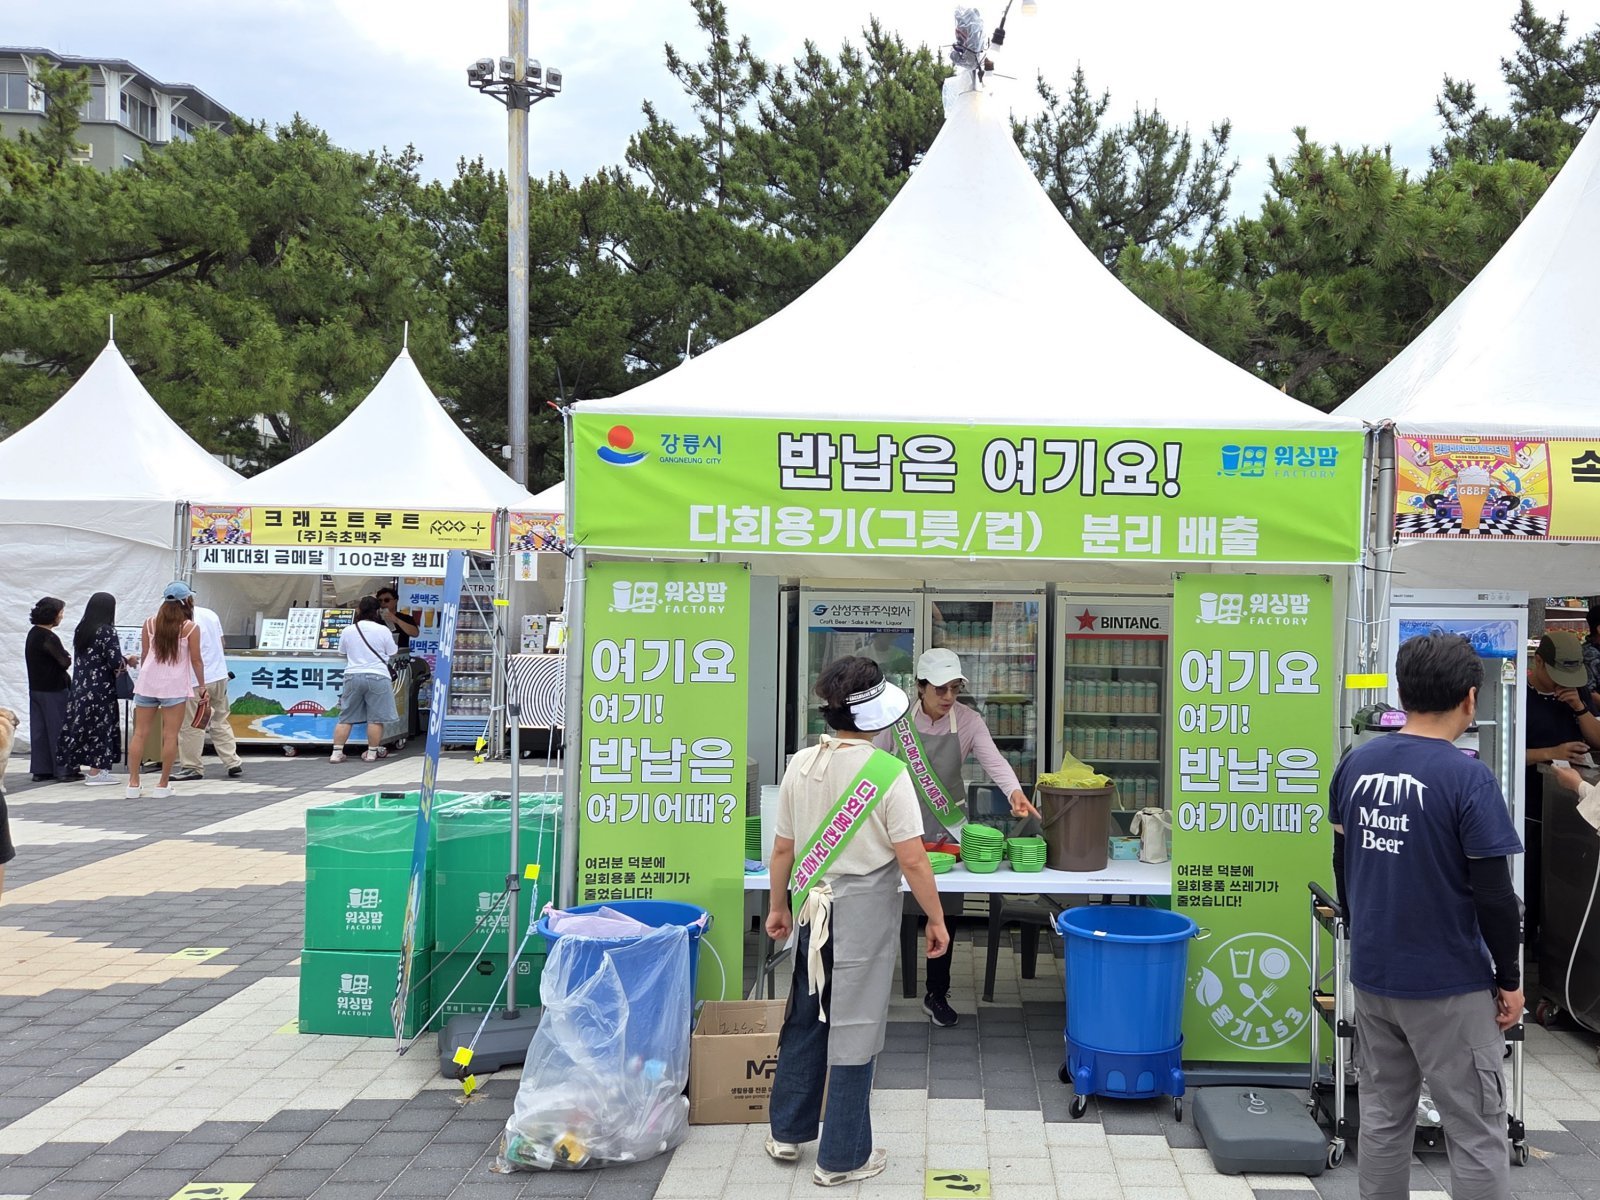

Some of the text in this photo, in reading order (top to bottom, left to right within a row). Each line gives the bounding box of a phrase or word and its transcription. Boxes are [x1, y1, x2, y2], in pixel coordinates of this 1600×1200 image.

[659, 432, 722, 455] 강릉시
[659, 456, 722, 465] GANGNEUNG CITY
[776, 431, 1183, 498] 반납은 여기요!
[1274, 445, 1339, 468] 워싱맘
[1274, 469, 1336, 479] FACTORY
[1459, 486, 1487, 495] GBBF
[297, 530, 382, 545] (주)속초맥주
[689, 504, 1260, 556] 다회용기(그릇/컵) 분리 배출
[203, 548, 325, 566] 세계대회 금메달
[338, 551, 445, 570] 100관왕 챔피
[410, 592, 439, 605] 생맥주
[664, 581, 728, 603] 워싱맘
[665, 604, 726, 614] FACTORY
[831, 604, 912, 617] 삼성주류주식회사
[1249, 593, 1311, 615] 워싱맘
[1101, 616, 1160, 629] BINTANG
[1249, 616, 1309, 626] FACTORY
[591, 637, 737, 685] 여기요
[251, 666, 345, 691] 속초맥주
[1180, 649, 1321, 695] 여기요
[588, 693, 665, 724] 여기!
[1178, 703, 1251, 735] 여기!
[588, 736, 735, 784] 반납은
[1179, 747, 1321, 794] 반납은
[586, 792, 738, 824] 여기어때?
[1178, 801, 1325, 834] 여기어때?
[1358, 806, 1410, 832] Mont
[1361, 828, 1405, 855] Beer
[585, 856, 666, 870] 여러분 덕분에
[1177, 864, 1254, 878] 여러분 덕분에
[584, 871, 691, 885] 일회용품 쓰레기가
[1177, 879, 1279, 893] 일회용품 쓰레기가
[584, 887, 653, 901] 줄었습니다!
[1177, 894, 1242, 908] 줄었습니다!
[345, 911, 384, 924] 워싱맘
[336, 997, 374, 1011] 워싱맘
